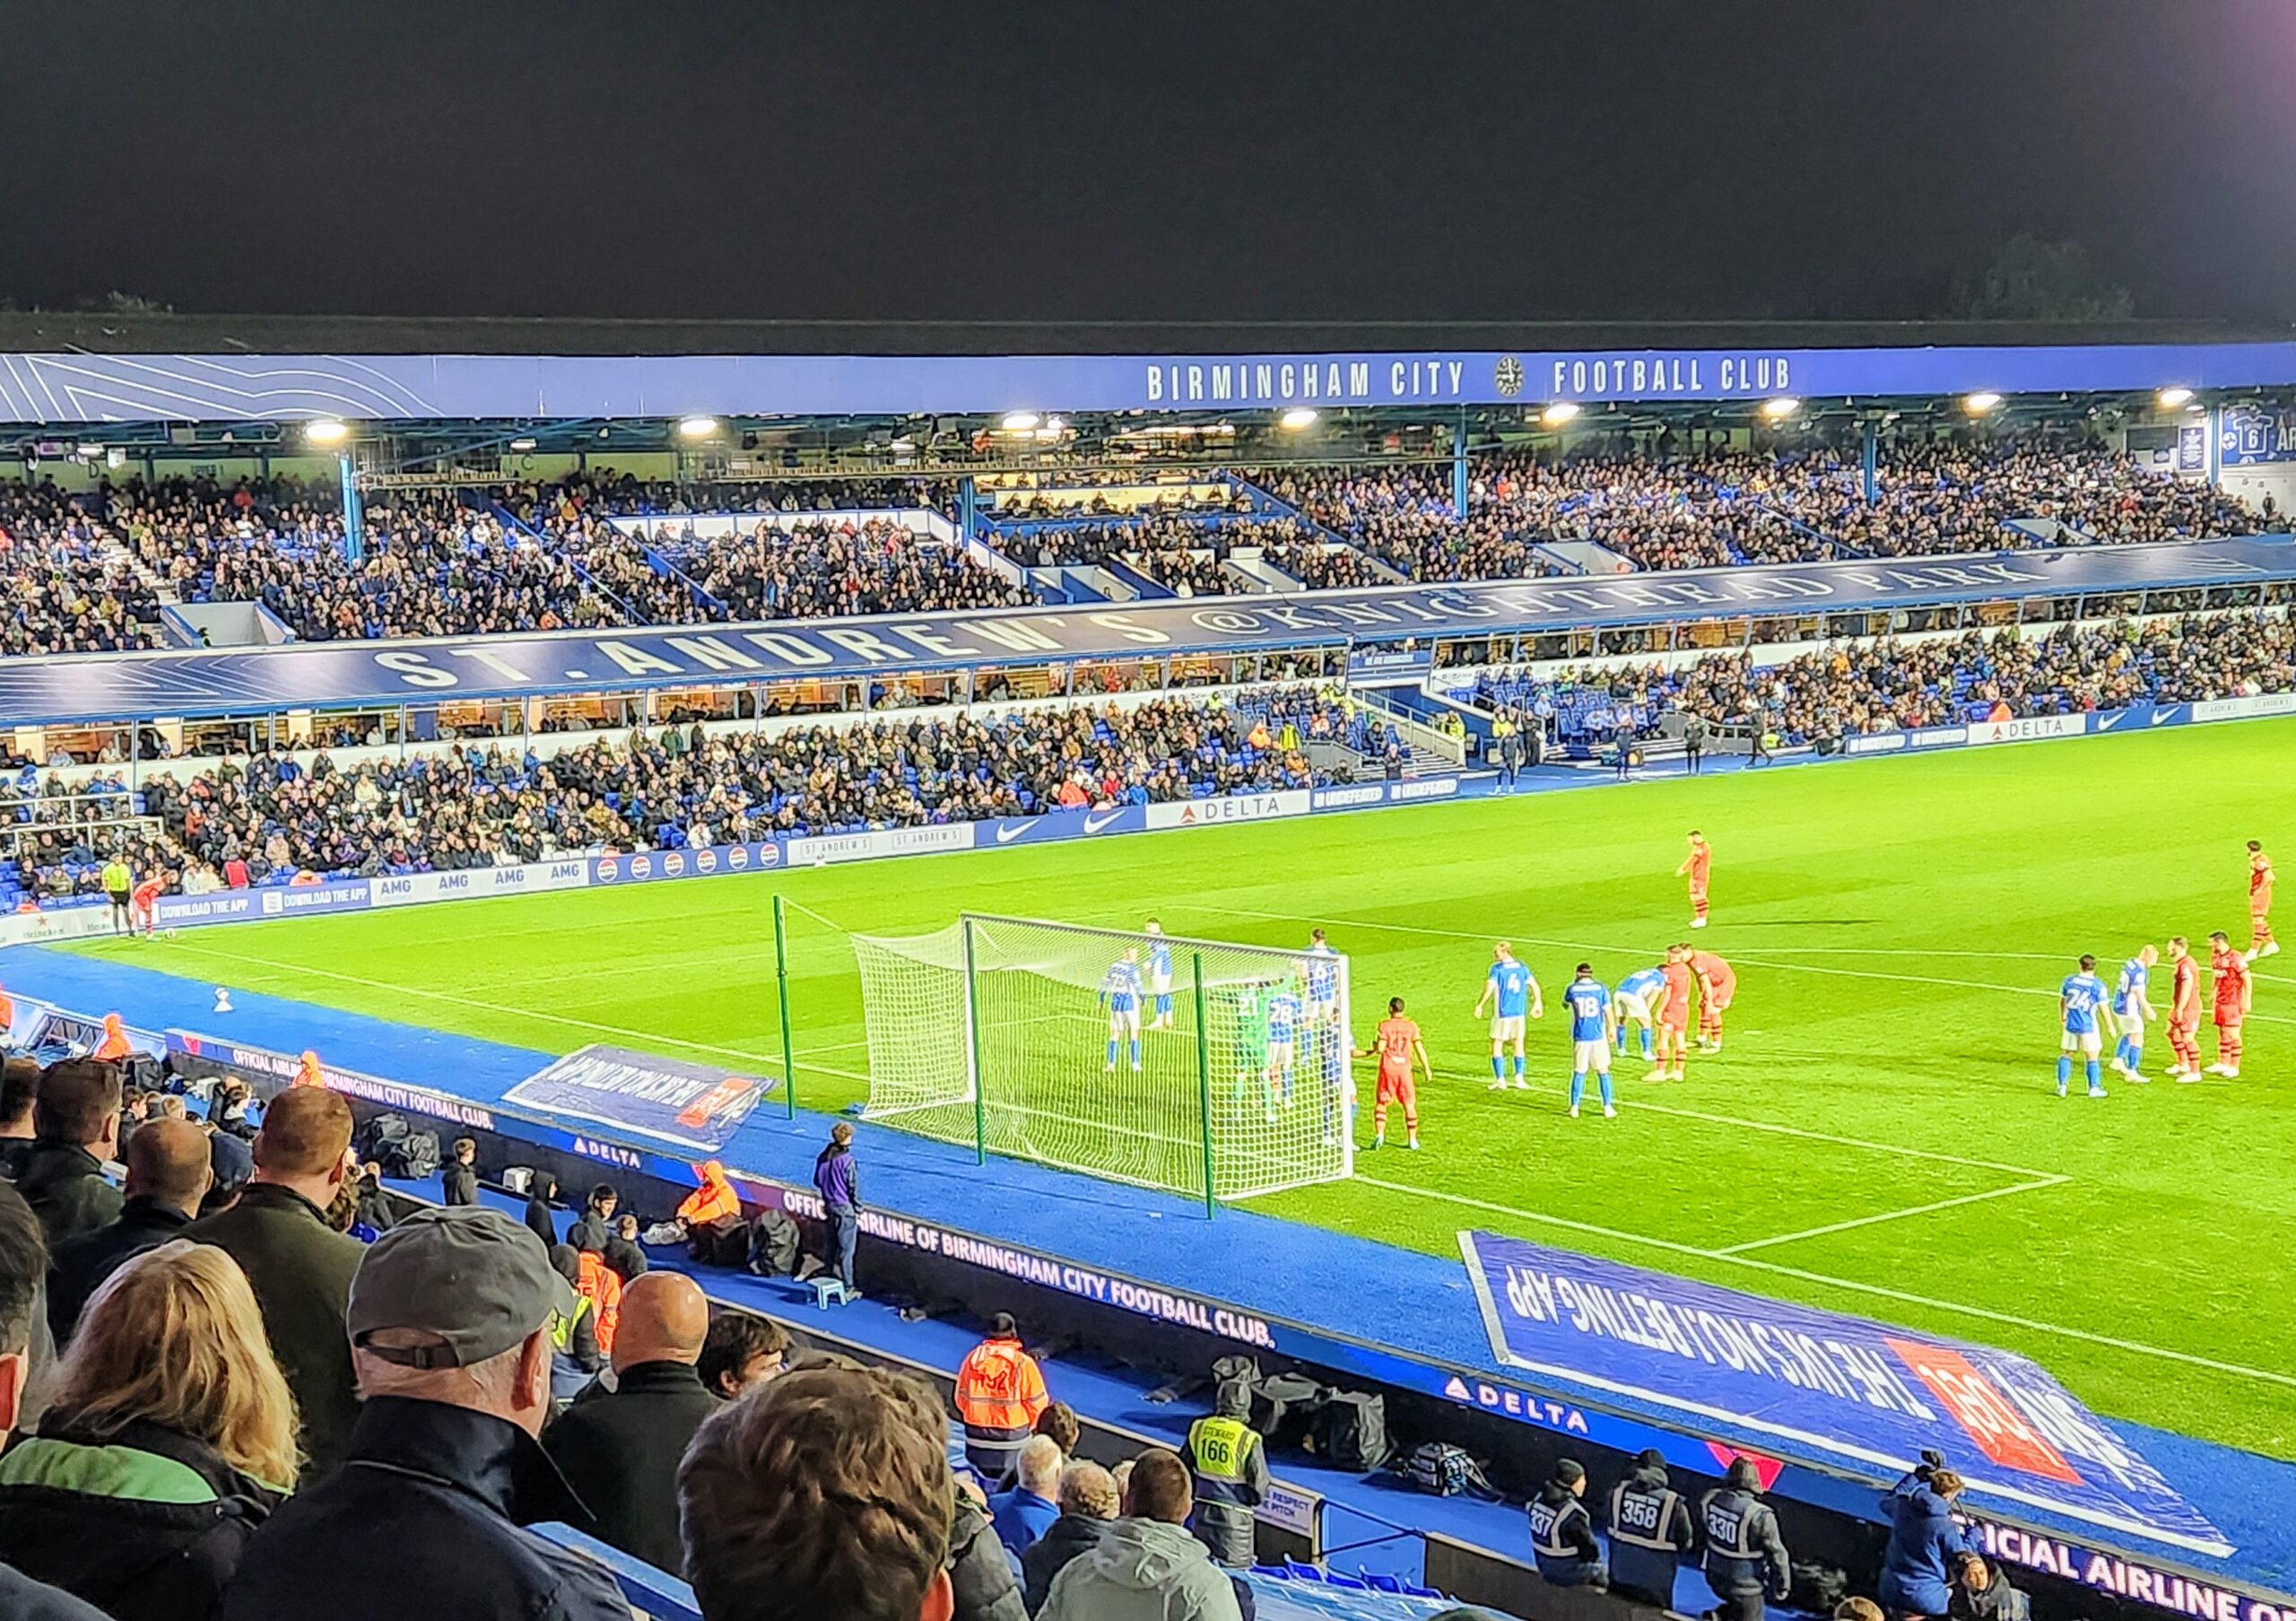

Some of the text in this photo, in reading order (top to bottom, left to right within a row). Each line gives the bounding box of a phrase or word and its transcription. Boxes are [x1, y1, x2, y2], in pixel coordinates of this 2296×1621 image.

[1147, 358, 1790, 401] BIRMINGHAM CITY FOOTBALL CLUB
[2248, 429, 2259, 449] 6
[594, 615, 1171, 675] ANDREW'S
[1831, 562, 2050, 592] PARK
[2009, 719, 2064, 736] DELTA
[1205, 797, 1279, 819] DELTA
[439, 875, 468, 889] AMG
[495, 869, 525, 884] AMG
[551, 864, 579, 879] AMG
[284, 892, 332, 907] DOWNLOAD
[333, 890, 350, 902] THE
[350, 888, 368, 900] APP
[380, 880, 412, 895] AMG
[161, 899, 248, 919] DOWNLOAD THE APP
[1508, 972, 1521, 994] 4
[1574, 997, 1600, 1018] 18
[2066, 989, 2090, 1012] 24
[232, 1049, 272, 1071] OFFICIAL
[273, 1059, 303, 1077] AIRLIN
[385, 1088, 408, 1107] CITY
[409, 1093, 462, 1122] FOOTBALL
[588, 1140, 641, 1169] DELTA
[783, 1191, 1276, 1349] OFFIC AIRLINE OF BIRMINGHAM CITY FOOTBALL CLUB.
[1506, 1265, 1560, 1325] APP
[1555, 1277, 1697, 1359] BETTING
[1822, 1339, 1938, 1421] THE
[1479, 1384, 1589, 1434] DELTA
[1201, 1437, 1230, 1463] 166
[1622, 1500, 1658, 1529] 358
[1708, 1513, 1737, 1543] 330
[1951, 1512, 2080, 1580] ICIAL
[2086, 1556, 2239, 1621] AIRLINE
